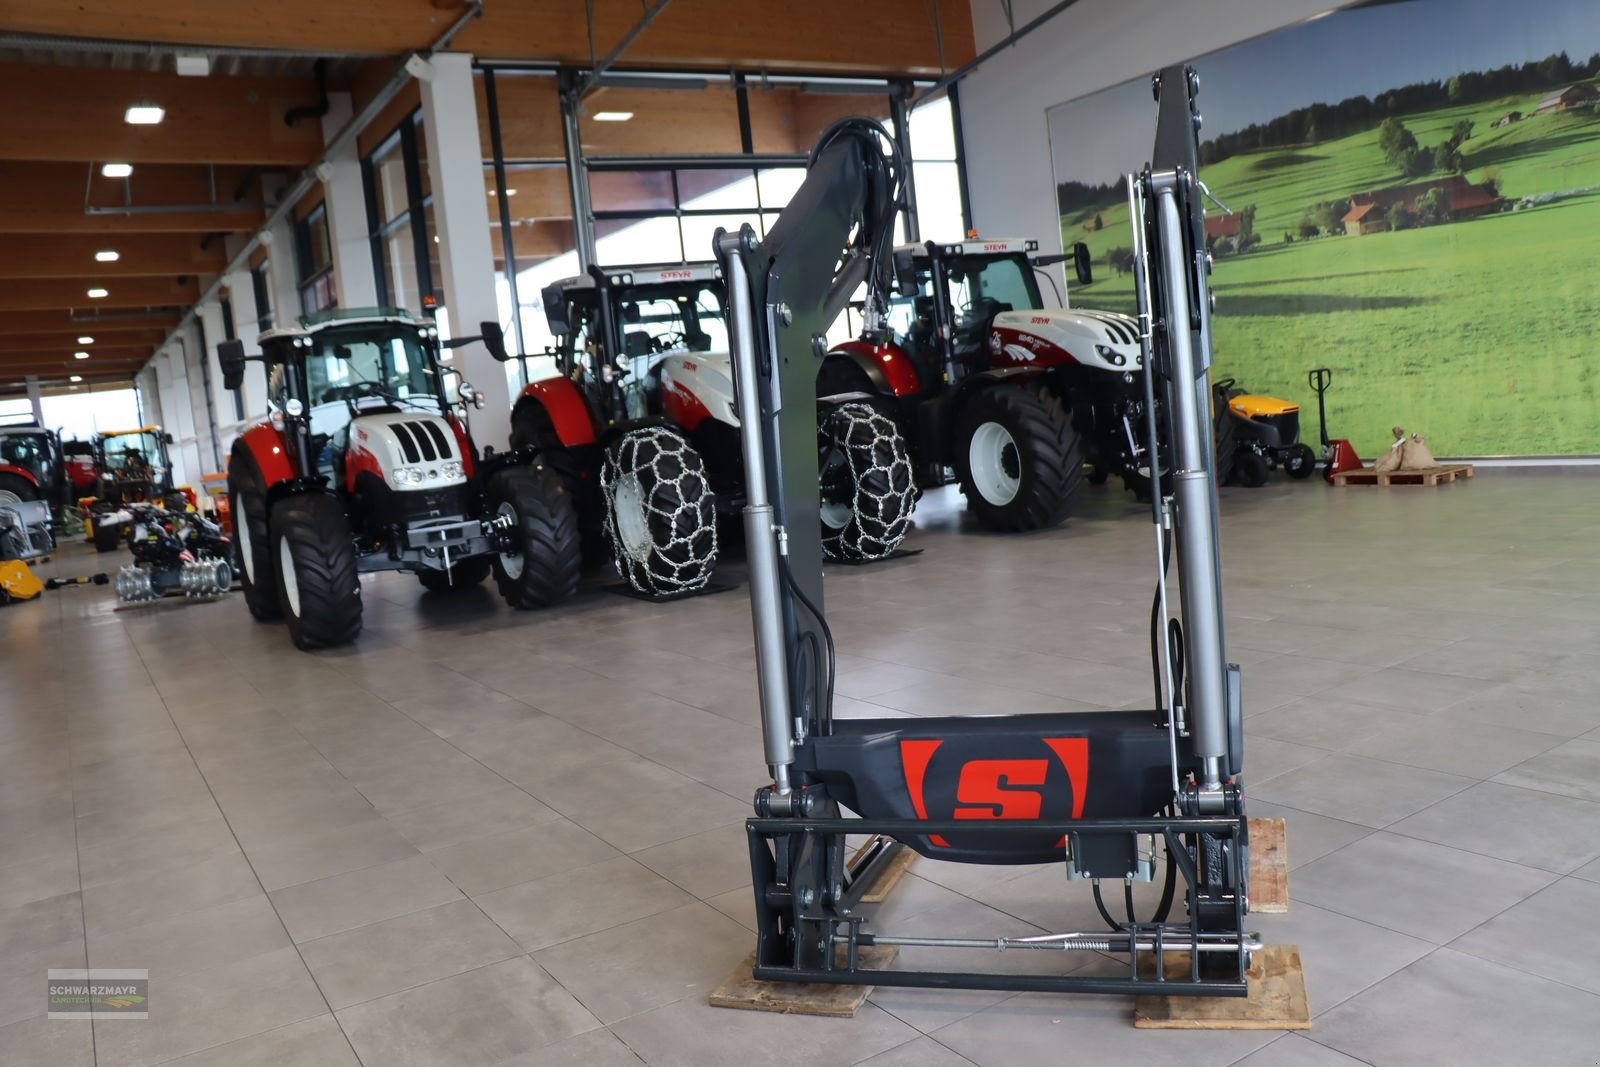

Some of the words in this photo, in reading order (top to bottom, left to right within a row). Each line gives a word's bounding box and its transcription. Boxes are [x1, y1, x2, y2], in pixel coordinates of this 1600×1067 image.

[984, 243, 1007, 251] STEYR
[660, 271, 691, 279] STEYR
[1030, 316, 1050, 325] STEYR
